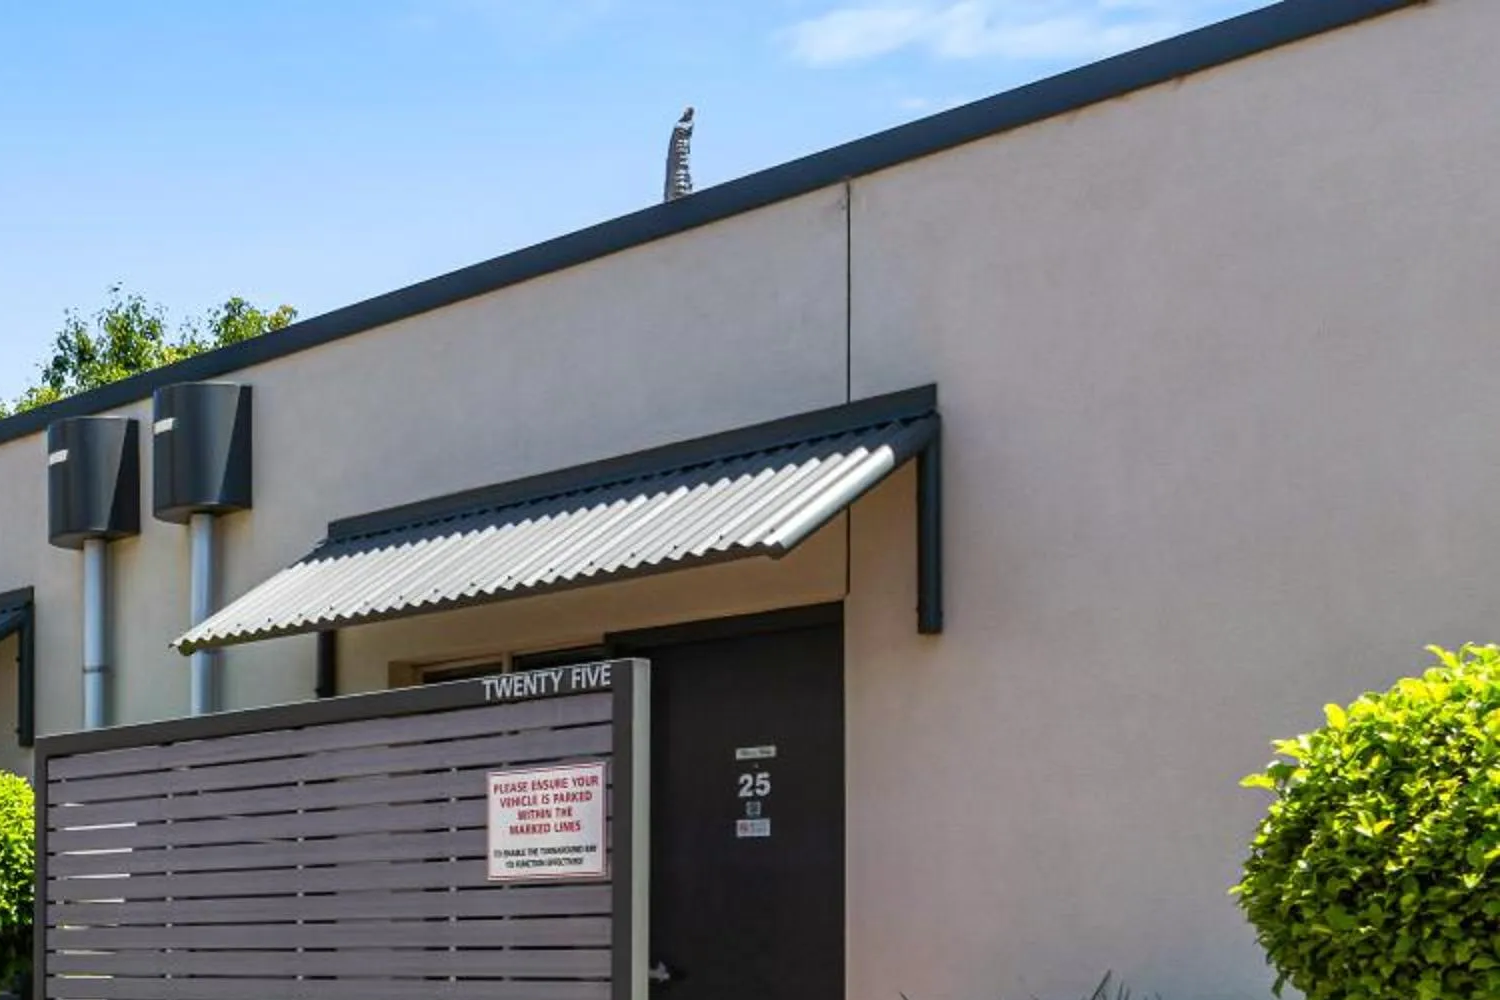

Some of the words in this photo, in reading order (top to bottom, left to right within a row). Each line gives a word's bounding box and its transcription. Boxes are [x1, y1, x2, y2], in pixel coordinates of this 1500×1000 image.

[482, 671, 563, 701] TWENTY
[571, 663, 612, 689] FIVE
[493, 782, 528, 794] PLEASE
[531, 778, 568, 791] ENSURE
[572, 775, 599, 786] YOUR
[738, 772, 771, 797] 25
[500, 795, 537, 808] VEHICLE
[541, 794, 550, 804] IS
[553, 790, 593, 803] PARKED
[517, 808, 551, 820] WITHIN
[555, 806, 573, 817] THE
[509, 823, 551, 835] MARKED
[554, 820, 581, 832] LINES
